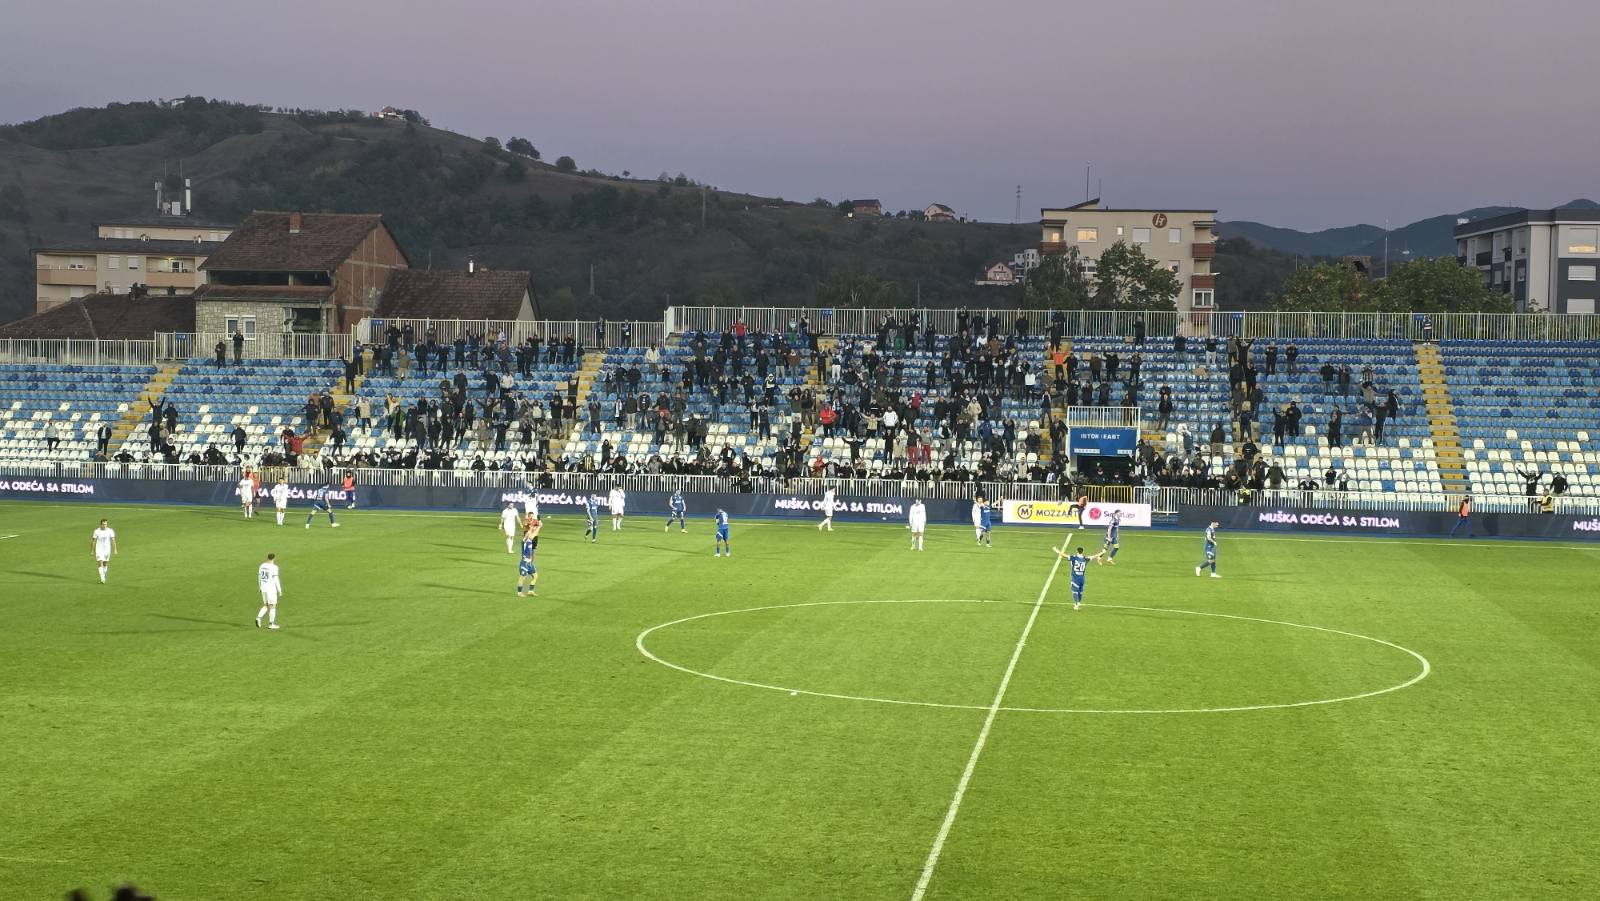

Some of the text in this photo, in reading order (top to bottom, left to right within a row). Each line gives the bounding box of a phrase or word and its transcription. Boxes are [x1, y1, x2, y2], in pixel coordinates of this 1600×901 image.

[12, 480, 44, 492] ODEĆA
[46, 482, 59, 492] SA
[61, 483, 94, 494] STILOM
[775, 498, 810, 510] MUŠKA
[850, 502, 863, 512] SA
[866, 502, 902, 514] STILOM
[1259, 511, 1400, 528] MUŠKA ODEĆA SA STILOM
[1073, 559, 1086, 572] 20
